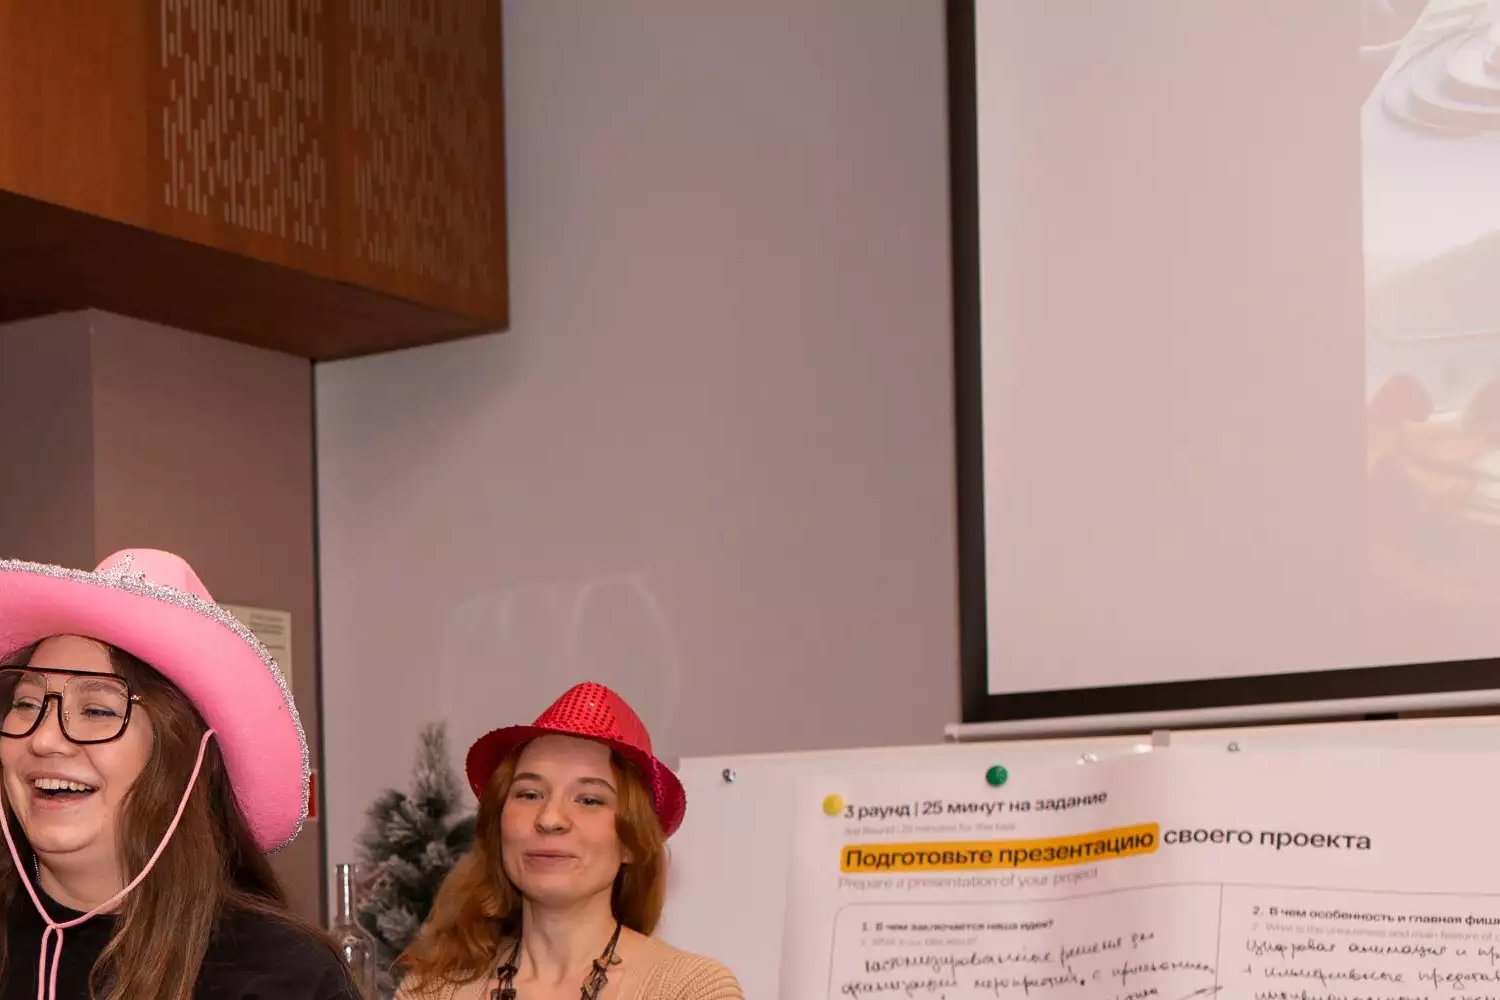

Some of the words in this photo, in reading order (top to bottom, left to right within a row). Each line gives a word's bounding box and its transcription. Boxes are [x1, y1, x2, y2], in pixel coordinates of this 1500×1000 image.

[844, 804, 854, 819] 3
[858, 802, 910, 820] раунд
[922, 801, 943, 815] 25
[947, 800, 1004, 818] минут
[1009, 799, 1031, 812] на
[1035, 791, 1107, 811] задание
[846, 849, 992, 870] Подготовьте
[1000, 832, 1154, 867] презентацию
[1163, 828, 1253, 845] своего
[1260, 830, 1371, 851] проекта
[1281, 908, 1307, 918] чем
[1309, 908, 1395, 923] особенность
[1398, 914, 1406, 923] и
[1408, 914, 1462, 925] главная
